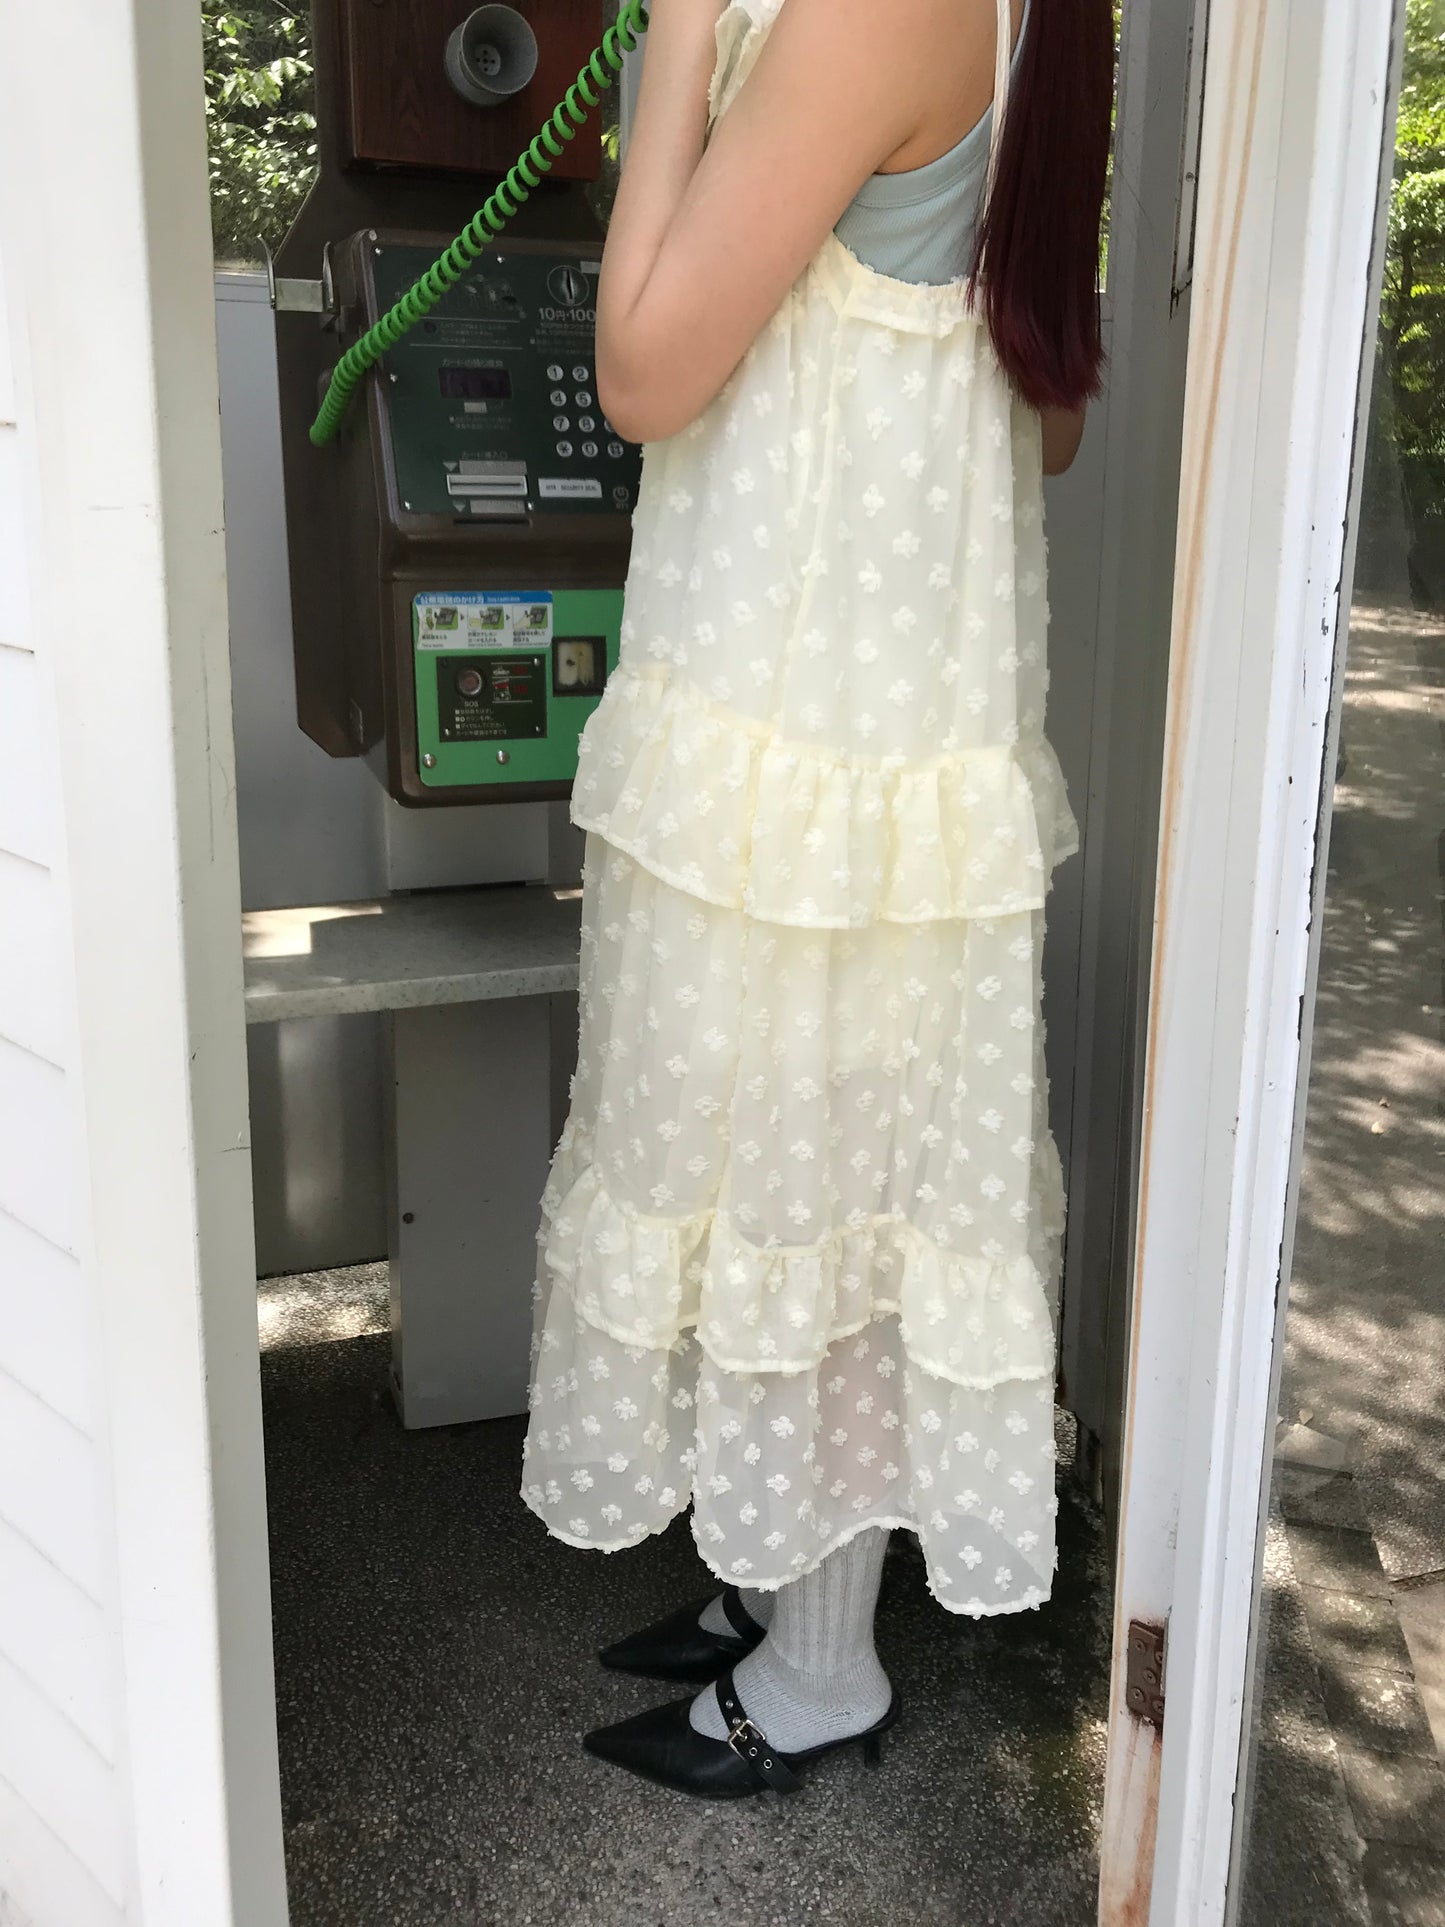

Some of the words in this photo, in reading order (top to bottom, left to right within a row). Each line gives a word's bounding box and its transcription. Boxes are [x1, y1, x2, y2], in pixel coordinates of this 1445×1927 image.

[576, 367, 585, 380] 2
[579, 394, 588, 405] 5
[556, 418, 564, 430] 7
[582, 419, 591, 430] 8
[464, 700, 479, 708] SOS
